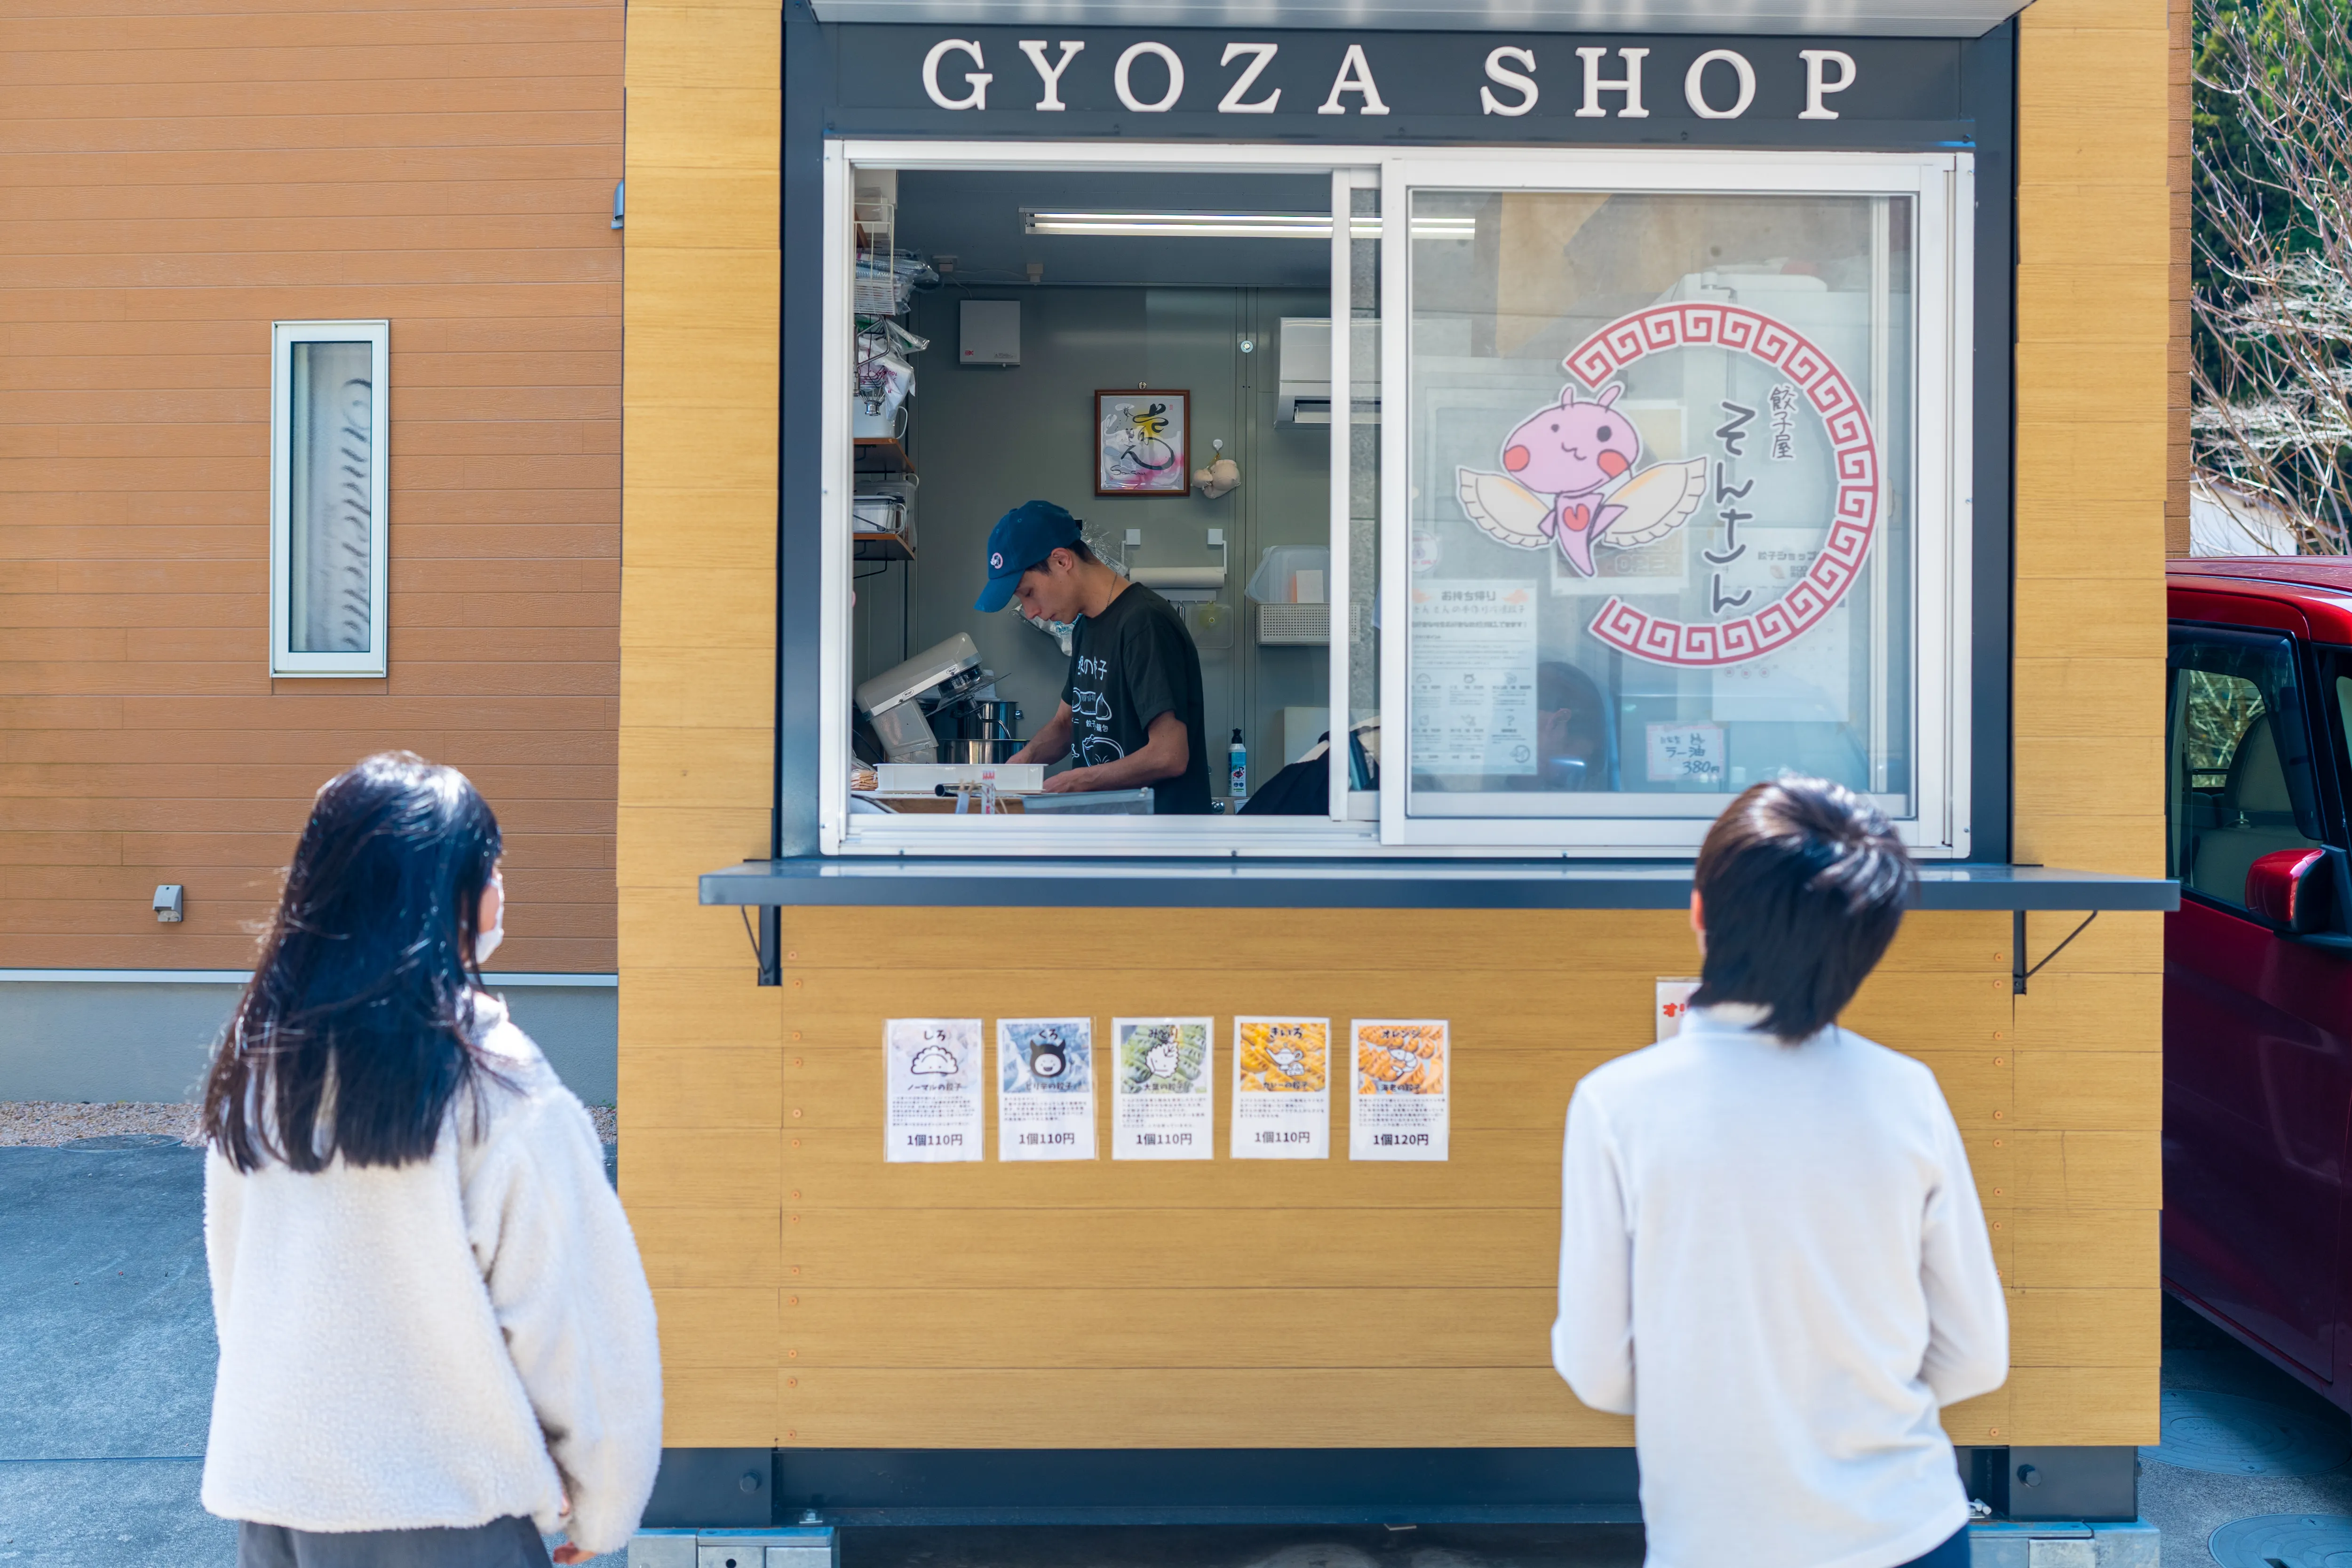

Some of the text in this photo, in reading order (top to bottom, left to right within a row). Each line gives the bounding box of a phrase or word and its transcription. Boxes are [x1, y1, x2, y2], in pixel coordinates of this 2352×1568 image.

[923, 39, 1856, 119] GYOZA SHOP
[1769, 386, 1797, 459] 餃子屋
[1704, 401, 1756, 613] そんさん
[1441, 590, 1496, 601] お持ち帰り
[1665, 745, 1706, 758] ラー油
[1682, 760, 1720, 775] 380円
[924, 1030, 946, 1041] しろ
[1039, 1029, 1058, 1040] くろ
[1270, 1027, 1303, 1039] きいろ
[1382, 1029, 1421, 1038] オレンジ
[907, 1134, 962, 1146] 1個110円
[1019, 1132, 1075, 1145] 1個110円
[1136, 1133, 1192, 1146] 1個110円
[1255, 1132, 1310, 1143] 1個110円
[1374, 1134, 1429, 1146] 1個120円
